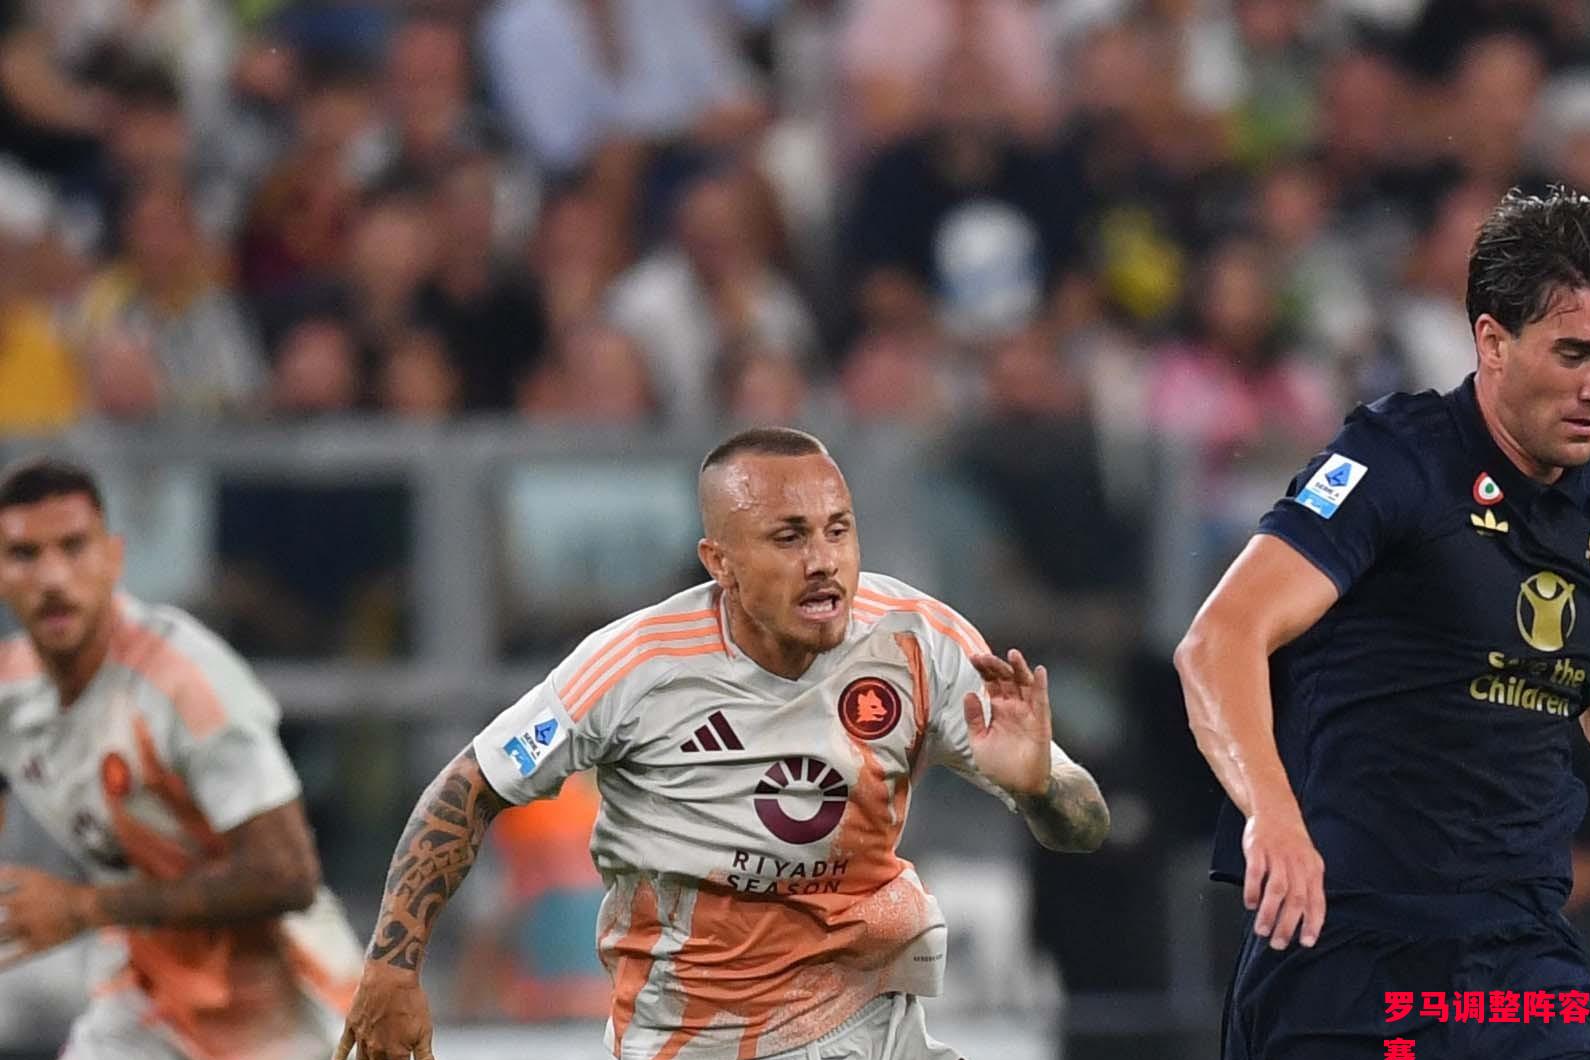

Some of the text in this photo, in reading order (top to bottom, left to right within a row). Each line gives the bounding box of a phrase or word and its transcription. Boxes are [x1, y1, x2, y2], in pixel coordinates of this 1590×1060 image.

[1487, 650, 1587, 687] Se the
[1469, 675, 1570, 717] Children
[732, 850, 849, 878] RIYADH
[726, 874, 842, 896] SEASON
